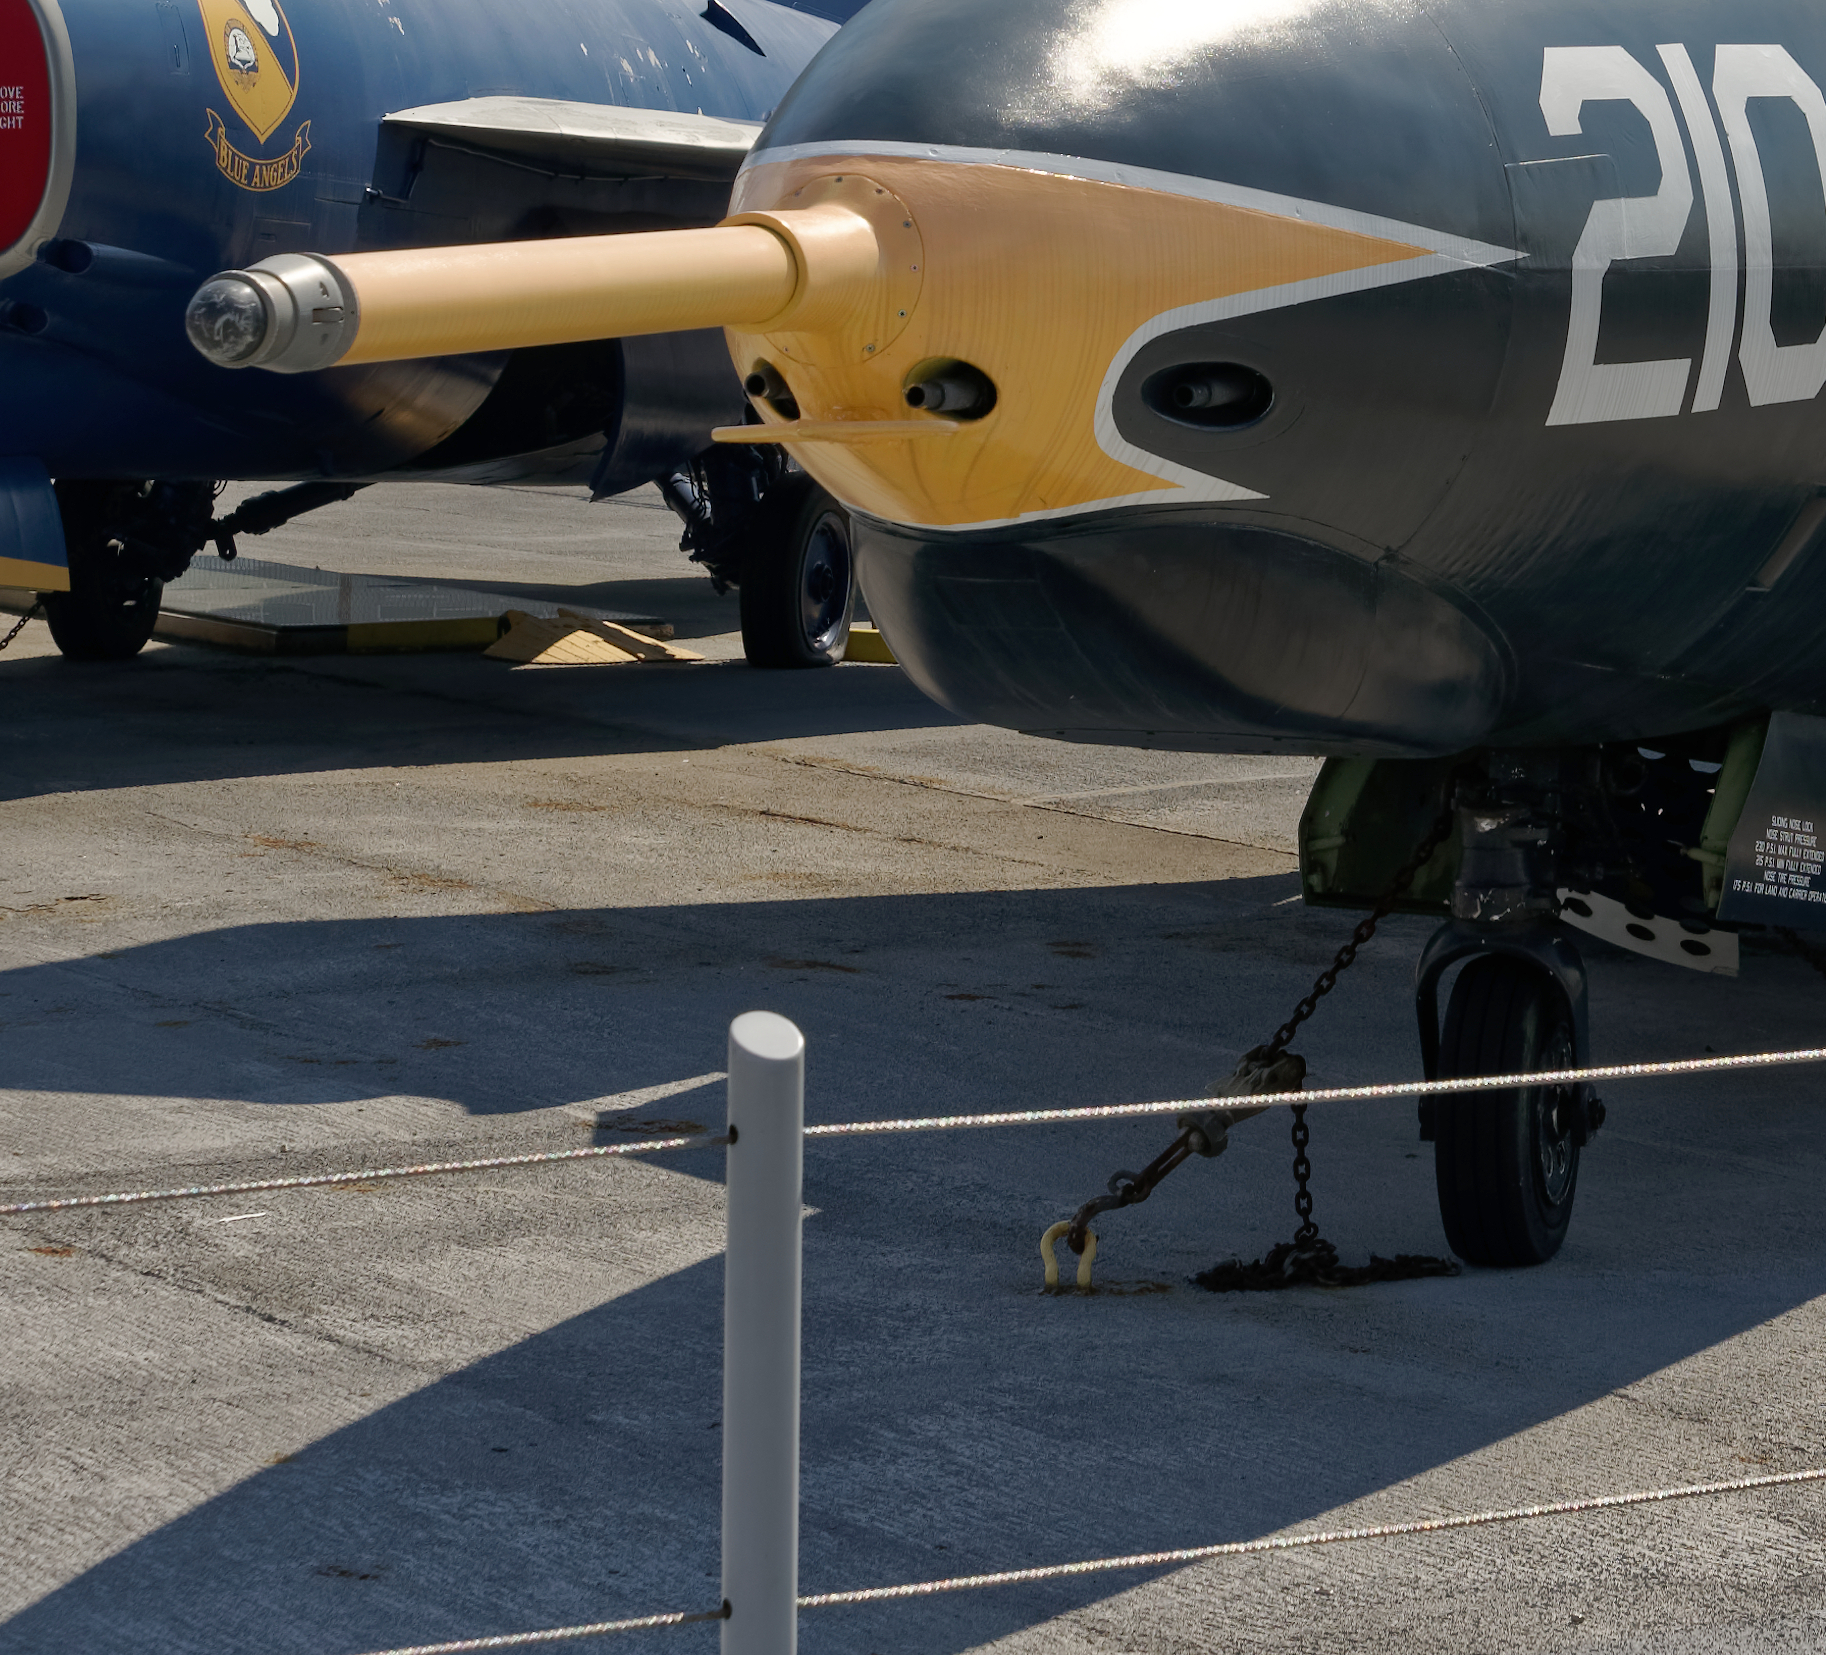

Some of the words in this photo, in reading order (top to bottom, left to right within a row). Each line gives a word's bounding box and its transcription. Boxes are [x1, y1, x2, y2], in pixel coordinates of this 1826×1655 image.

[219, 143, 250, 185] BLUE
[251, 150, 299, 188] ANGELS
[1766, 828, 1779, 841] NOSE
[1788, 846, 1803, 859] FULLY
[1802, 848, 1825, 863] EXTENDED
[1785, 859, 1800, 872] FULLY
[1799, 861, 1822, 876] EXTENDED
[1753, 882, 1765, 895] FOR
[1765, 884, 1778, 897] LAND
